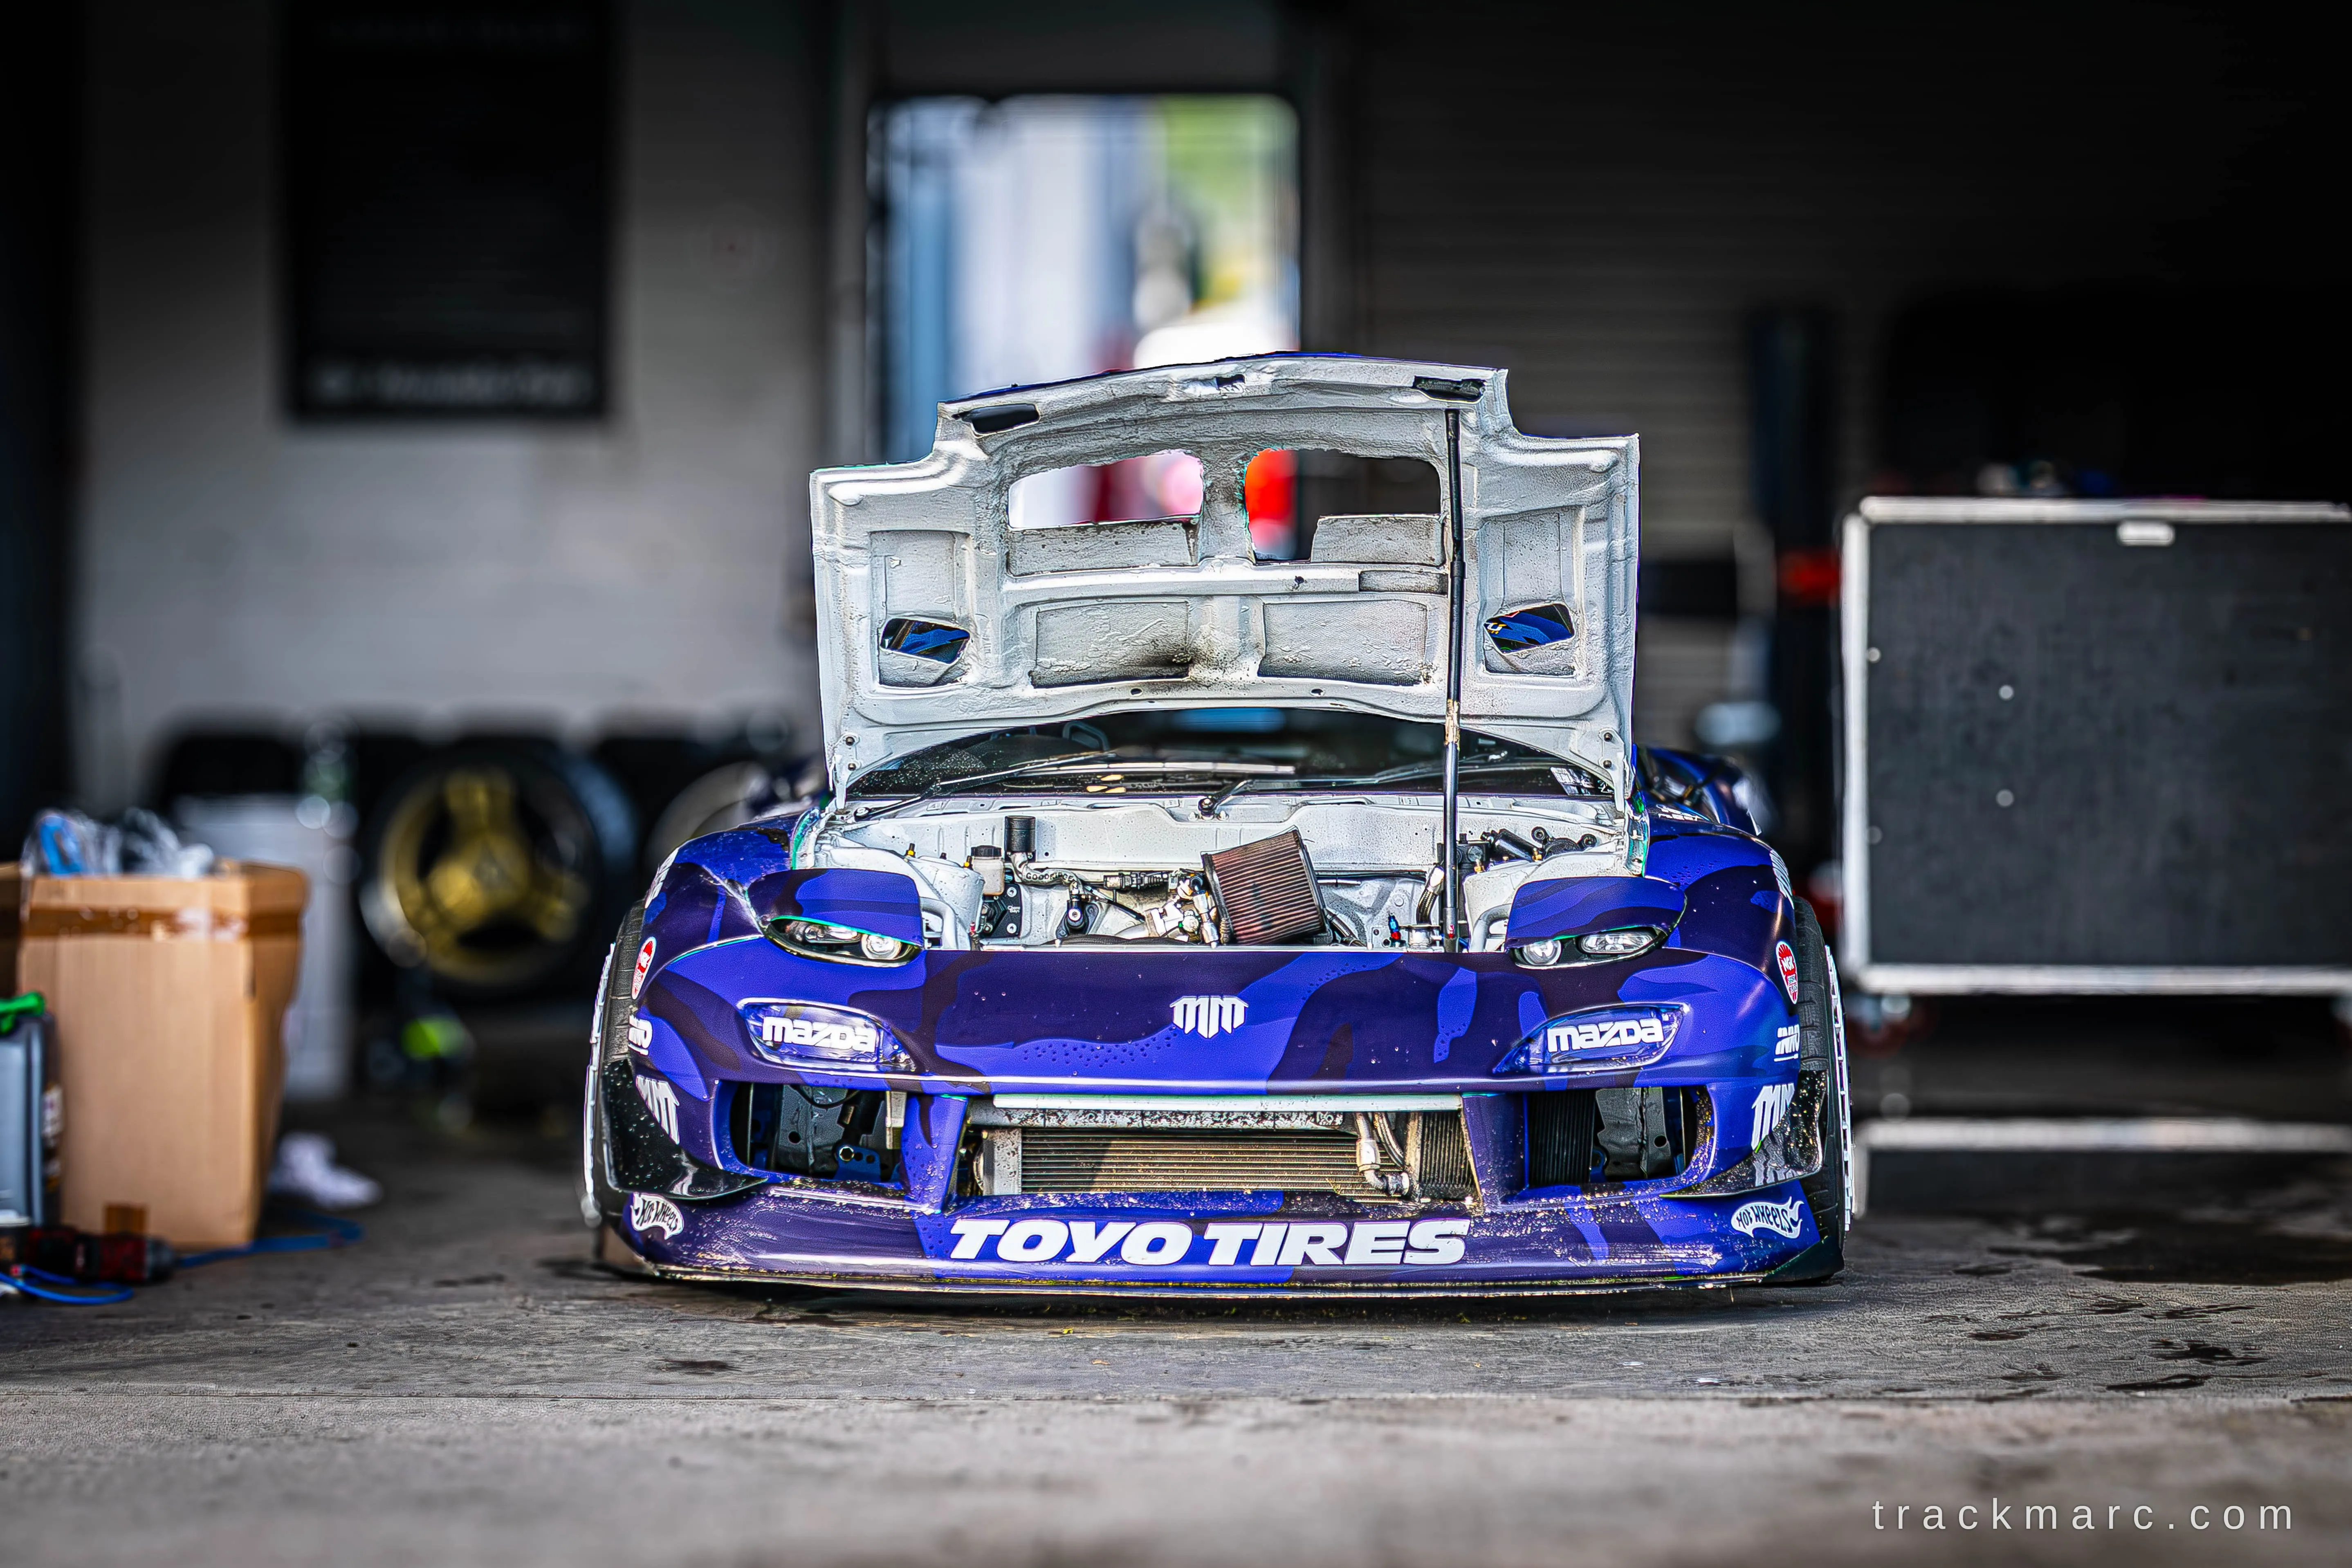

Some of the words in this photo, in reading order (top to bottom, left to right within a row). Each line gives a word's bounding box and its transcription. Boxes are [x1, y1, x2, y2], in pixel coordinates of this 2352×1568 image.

[1781, 956, 1795, 972] NGK
[950, 1219, 1193, 1265] TOYO
[1203, 1218, 1471, 1266] TIRES
